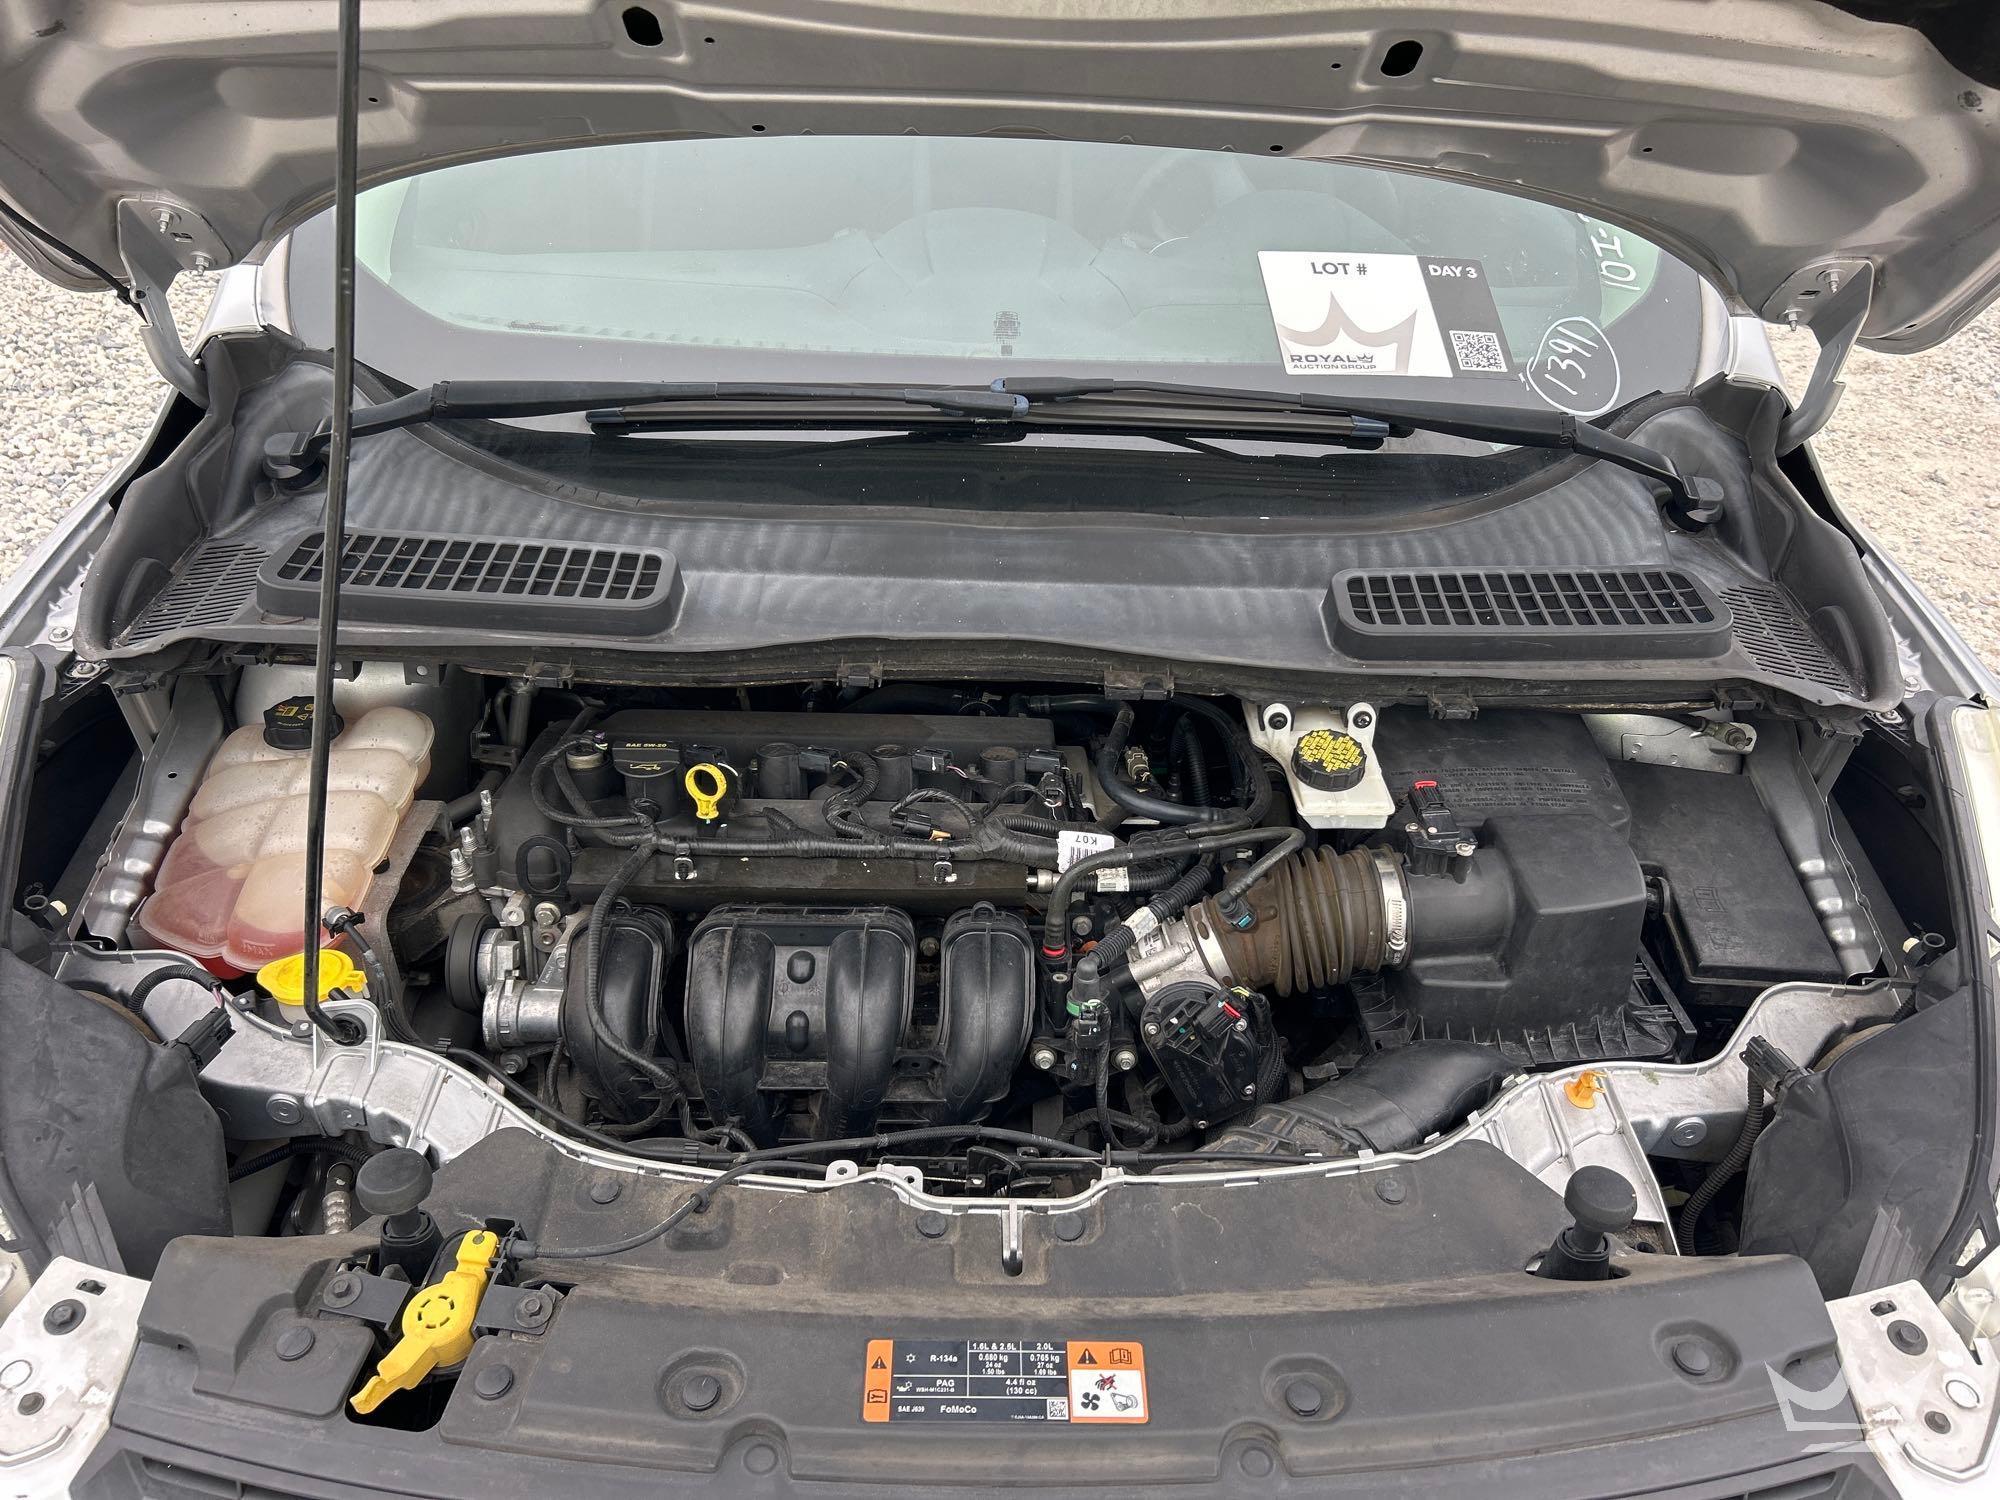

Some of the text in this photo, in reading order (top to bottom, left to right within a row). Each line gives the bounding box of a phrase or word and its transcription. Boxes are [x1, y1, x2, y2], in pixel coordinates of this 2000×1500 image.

[1310, 262, 1368, 276] LOT #
[1428, 264, 1478, 279] DAY 3
[1290, 353, 1358, 364] ROYAL
[1544, 325, 1599, 395] 1391
[1075, 834, 1097, 845] K07
[991, 1342, 998, 1350] &
[1036, 1343, 1054, 1351] 2.0L
[929, 1354, 958, 1363] R-134a
[999, 1353, 1008, 1362] kg
[1050, 1354, 1060, 1363] kg
[936, 1379, 955, 1387] PAG
[1006, 1386, 1038, 1395] (130 cc)
[897, 1405, 911, 1413] SAE
[939, 1405, 977, 1414] FoMoCo
